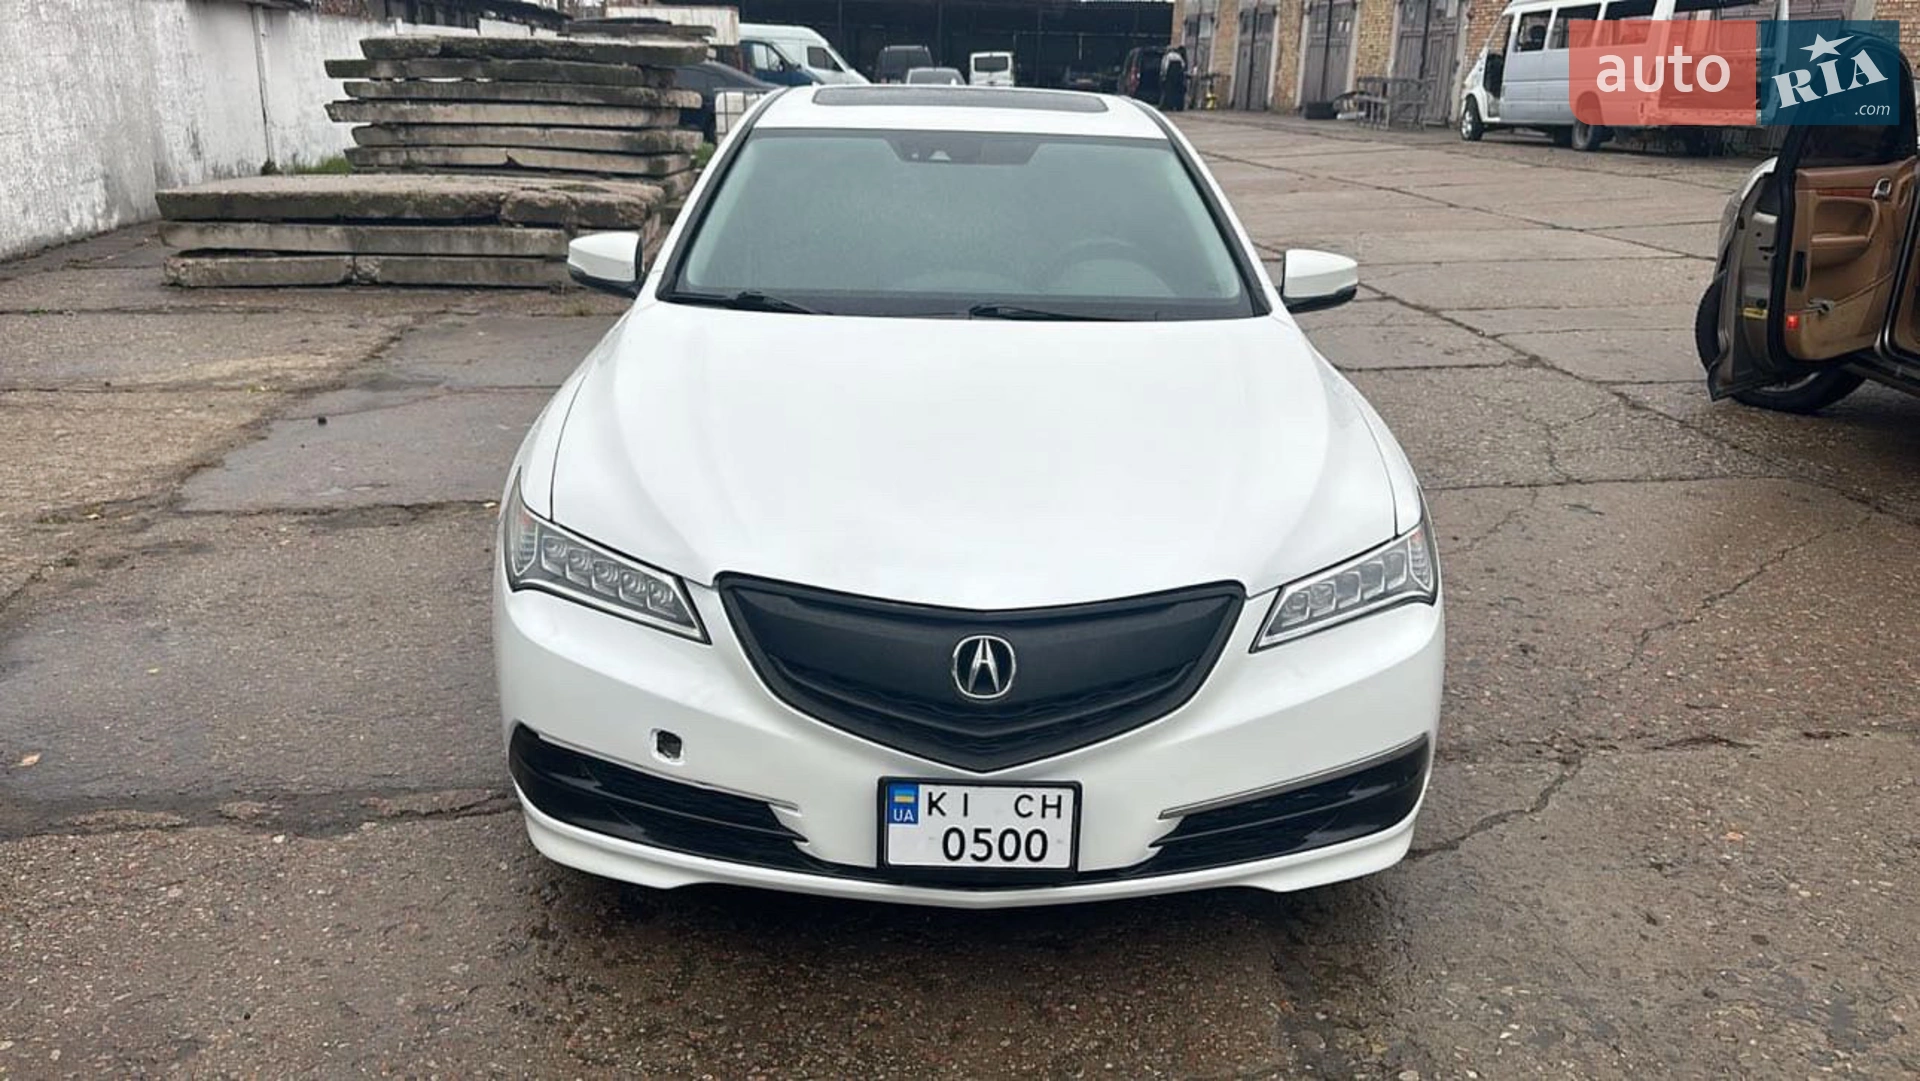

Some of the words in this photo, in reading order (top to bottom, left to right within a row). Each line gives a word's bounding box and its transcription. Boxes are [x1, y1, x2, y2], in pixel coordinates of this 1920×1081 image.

[893, 809, 915, 822] UA
[1014, 794, 1062, 819] CH
[942, 827, 1048, 863] 0500
